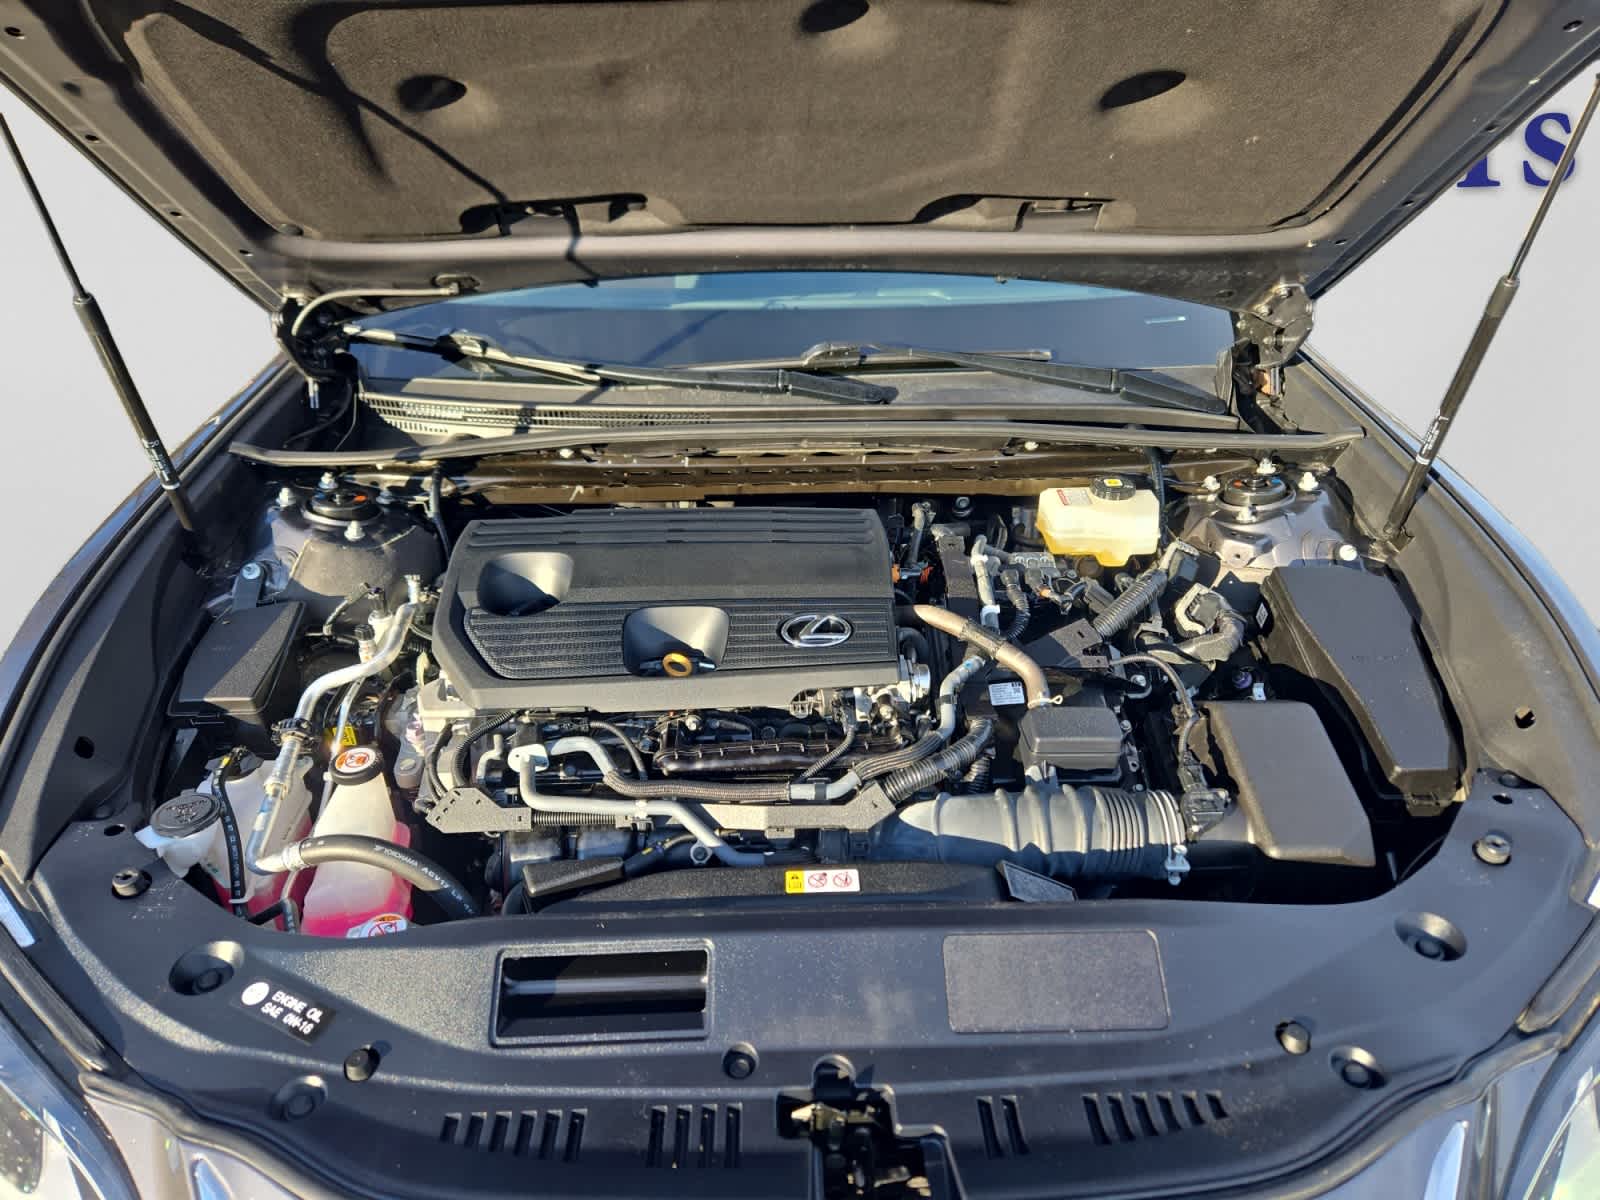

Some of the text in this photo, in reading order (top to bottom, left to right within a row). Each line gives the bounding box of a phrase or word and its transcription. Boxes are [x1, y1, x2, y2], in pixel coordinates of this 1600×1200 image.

[260, 1002, 284, 1019] SAE
[271, 990, 323, 1024] ENGINE OIL
